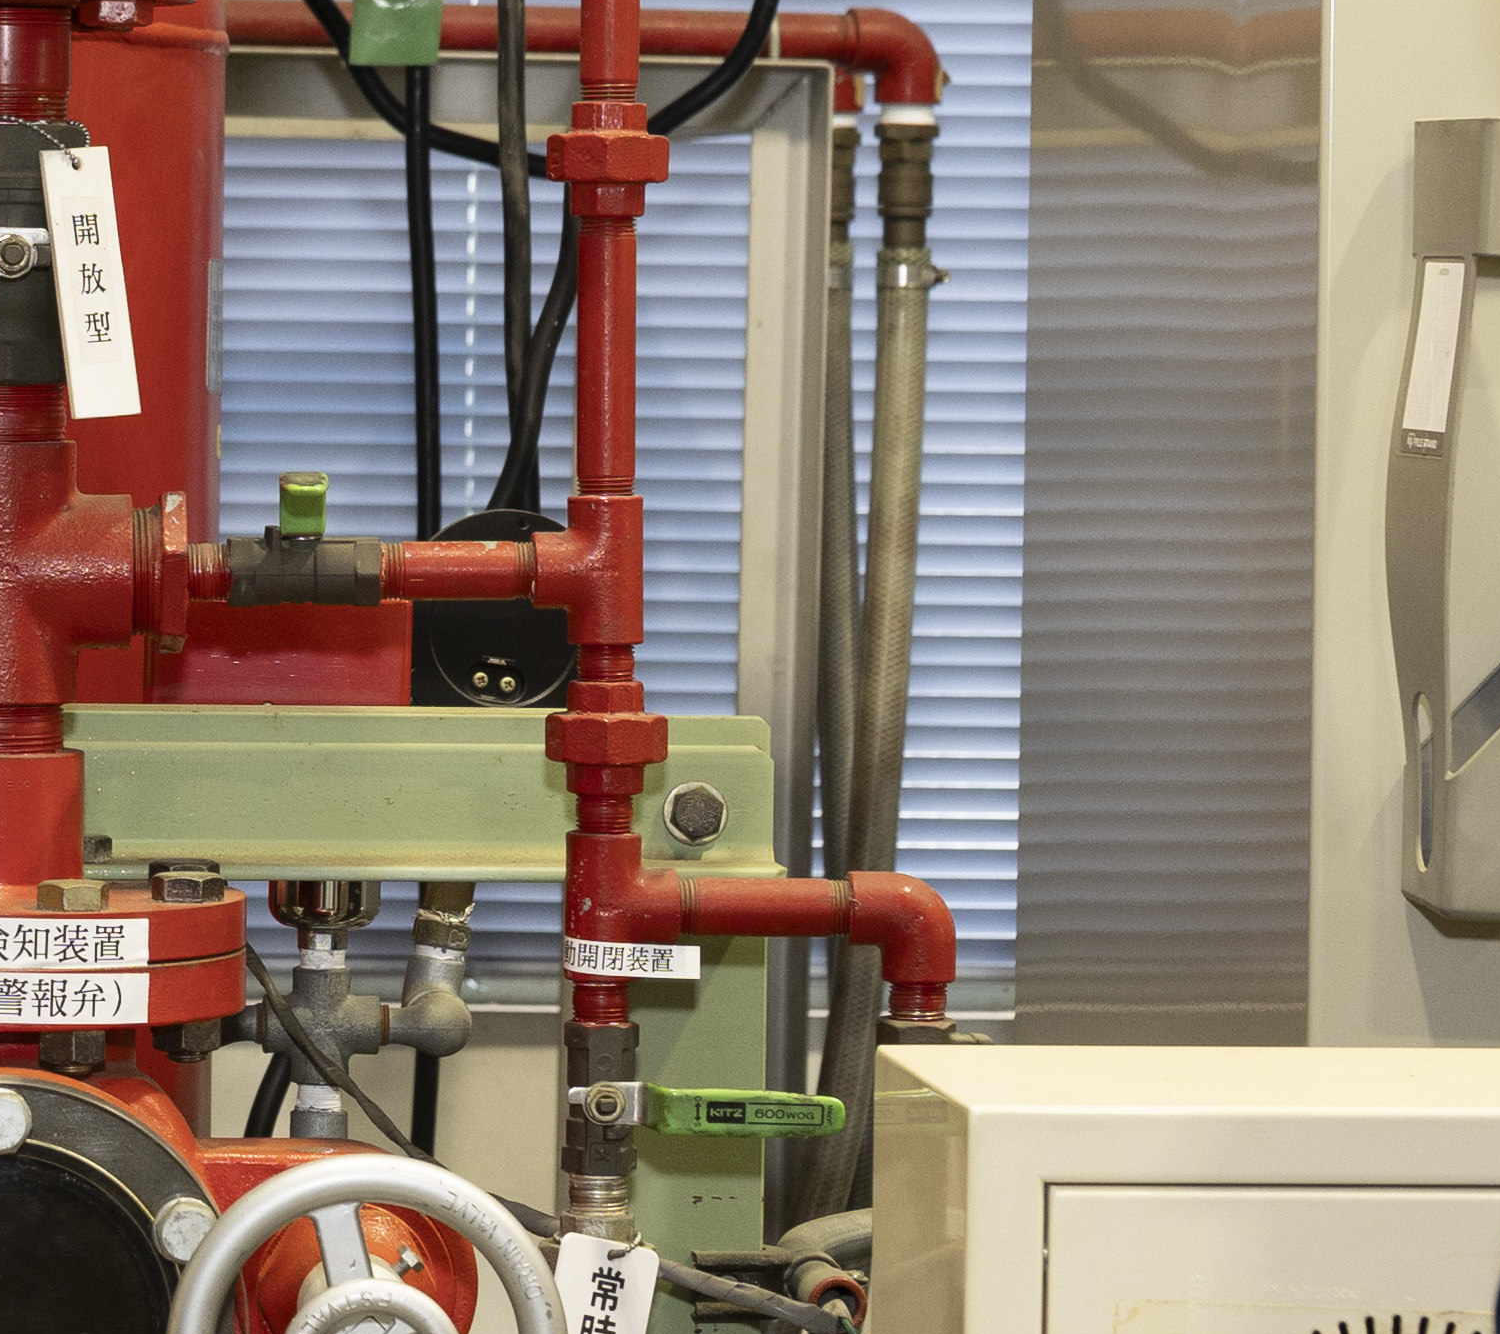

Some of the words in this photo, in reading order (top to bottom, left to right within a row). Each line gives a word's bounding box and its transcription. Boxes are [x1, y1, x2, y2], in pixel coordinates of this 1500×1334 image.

[70, 213, 113, 345] 開放型
[709, 1107, 744, 1118] KITZ
[754, 1108, 816, 1121] 600WOG
